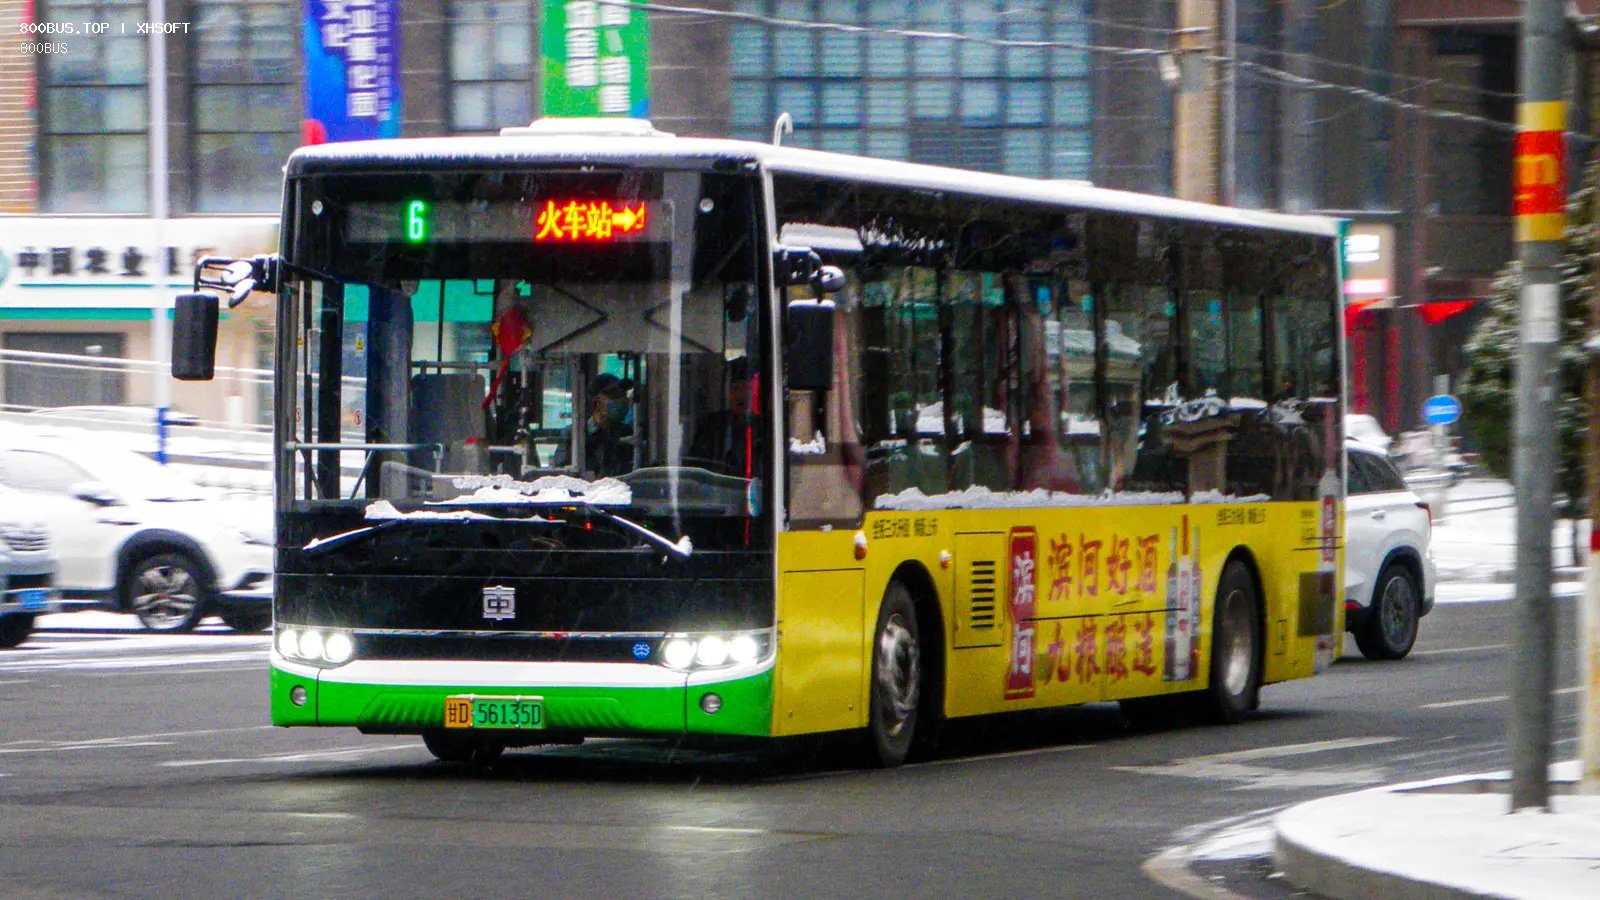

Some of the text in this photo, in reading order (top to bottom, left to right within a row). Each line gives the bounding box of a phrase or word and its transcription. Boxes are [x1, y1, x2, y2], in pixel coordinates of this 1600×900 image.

[408, 200, 425, 241] 6
[536, 199, 613, 240] 火车站
[1047, 532, 1160, 601] 滨河好酒
[1013, 551, 1036, 675] 滨河
[477, 702, 542, 725] 56135D
